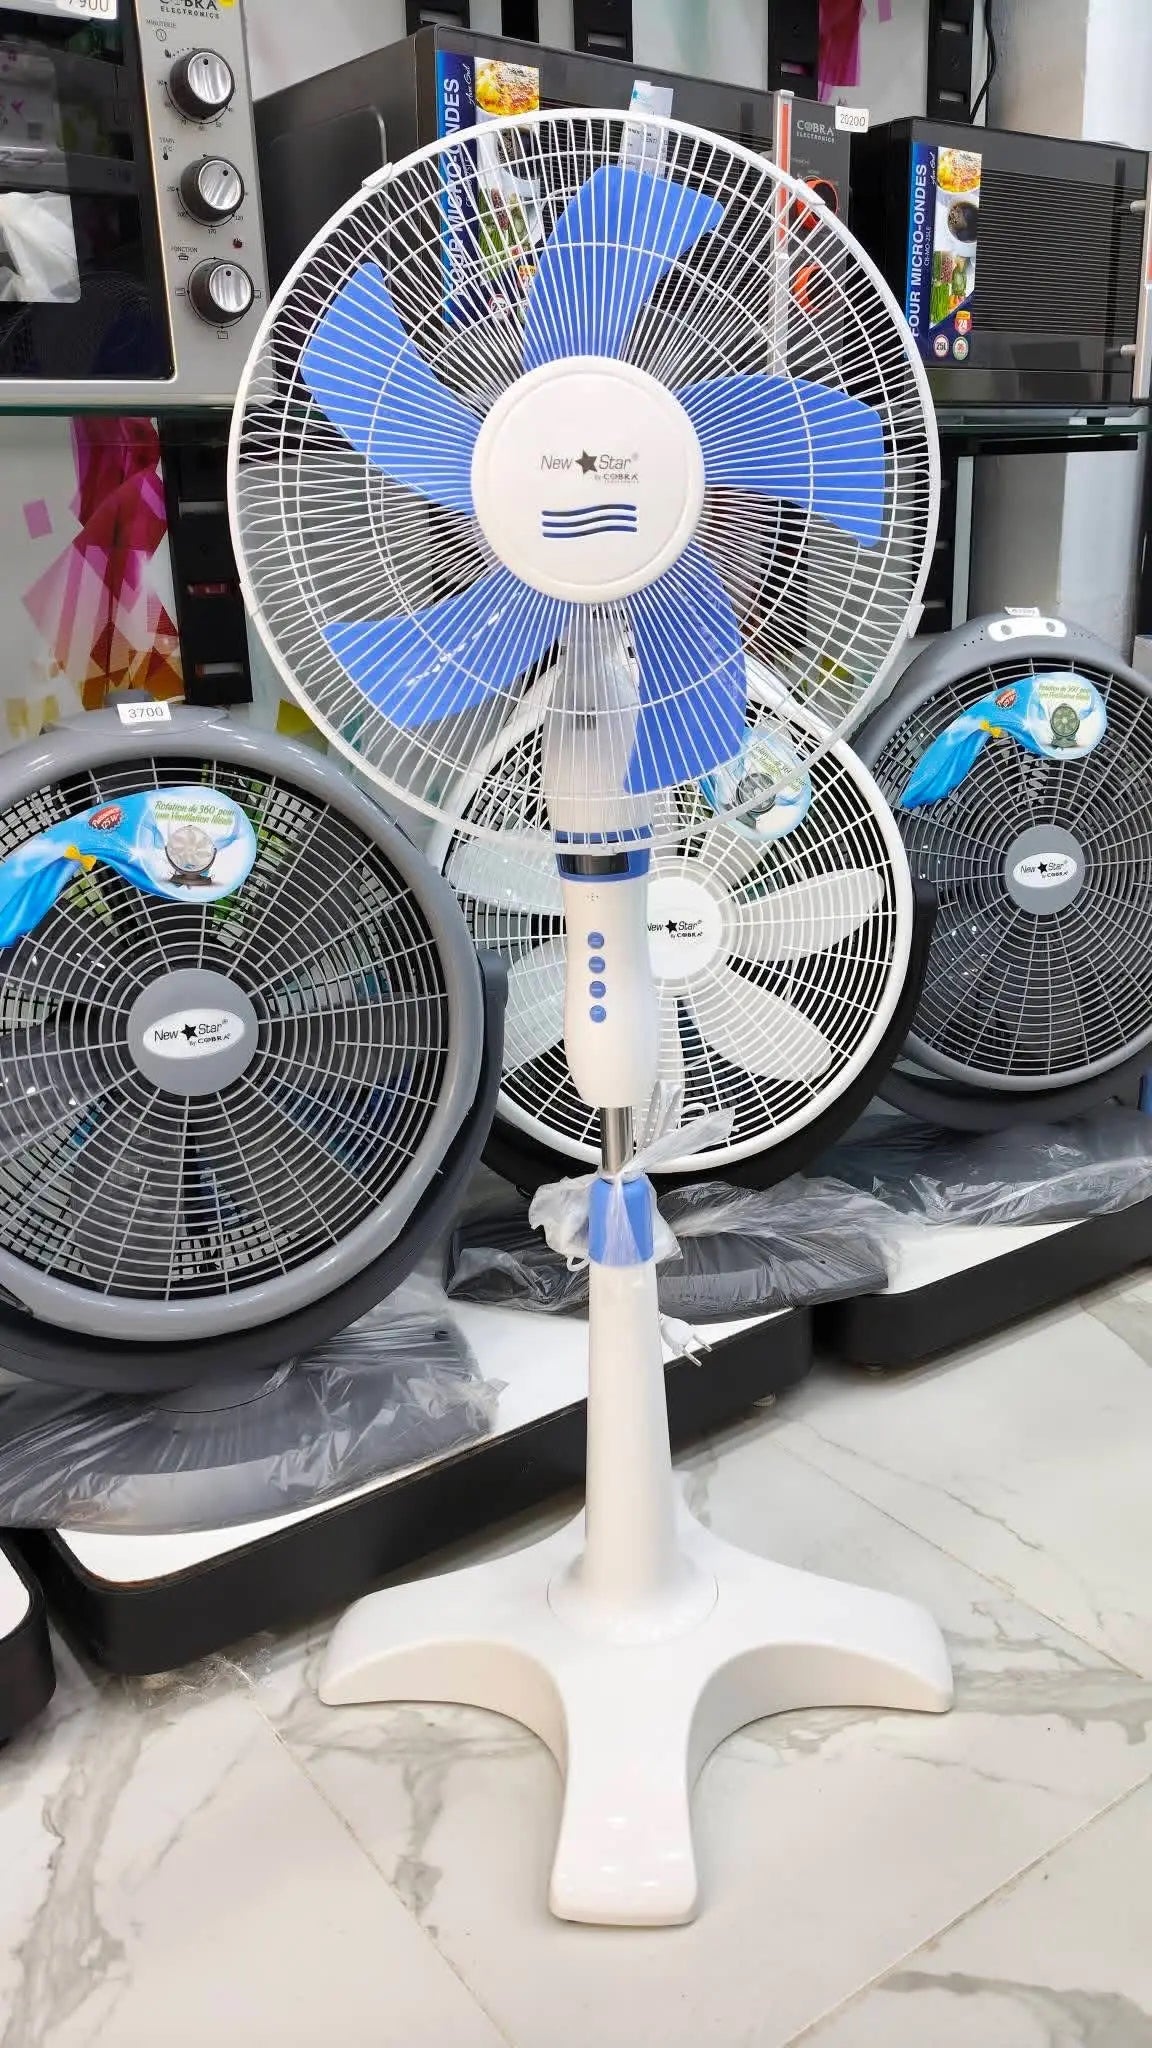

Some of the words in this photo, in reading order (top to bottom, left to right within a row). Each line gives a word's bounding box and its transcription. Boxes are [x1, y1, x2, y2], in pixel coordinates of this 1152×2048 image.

[160, 6, 219, 19] ELECTRONICS
[797, 120, 834, 136] COBRA
[911, 164, 927, 286] MICRO-ONDES
[541, 455, 573, 470] New
[128, 706, 164, 719] 3700
[1020, 865, 1036, 873] New
[154, 1029, 179, 1042] New
